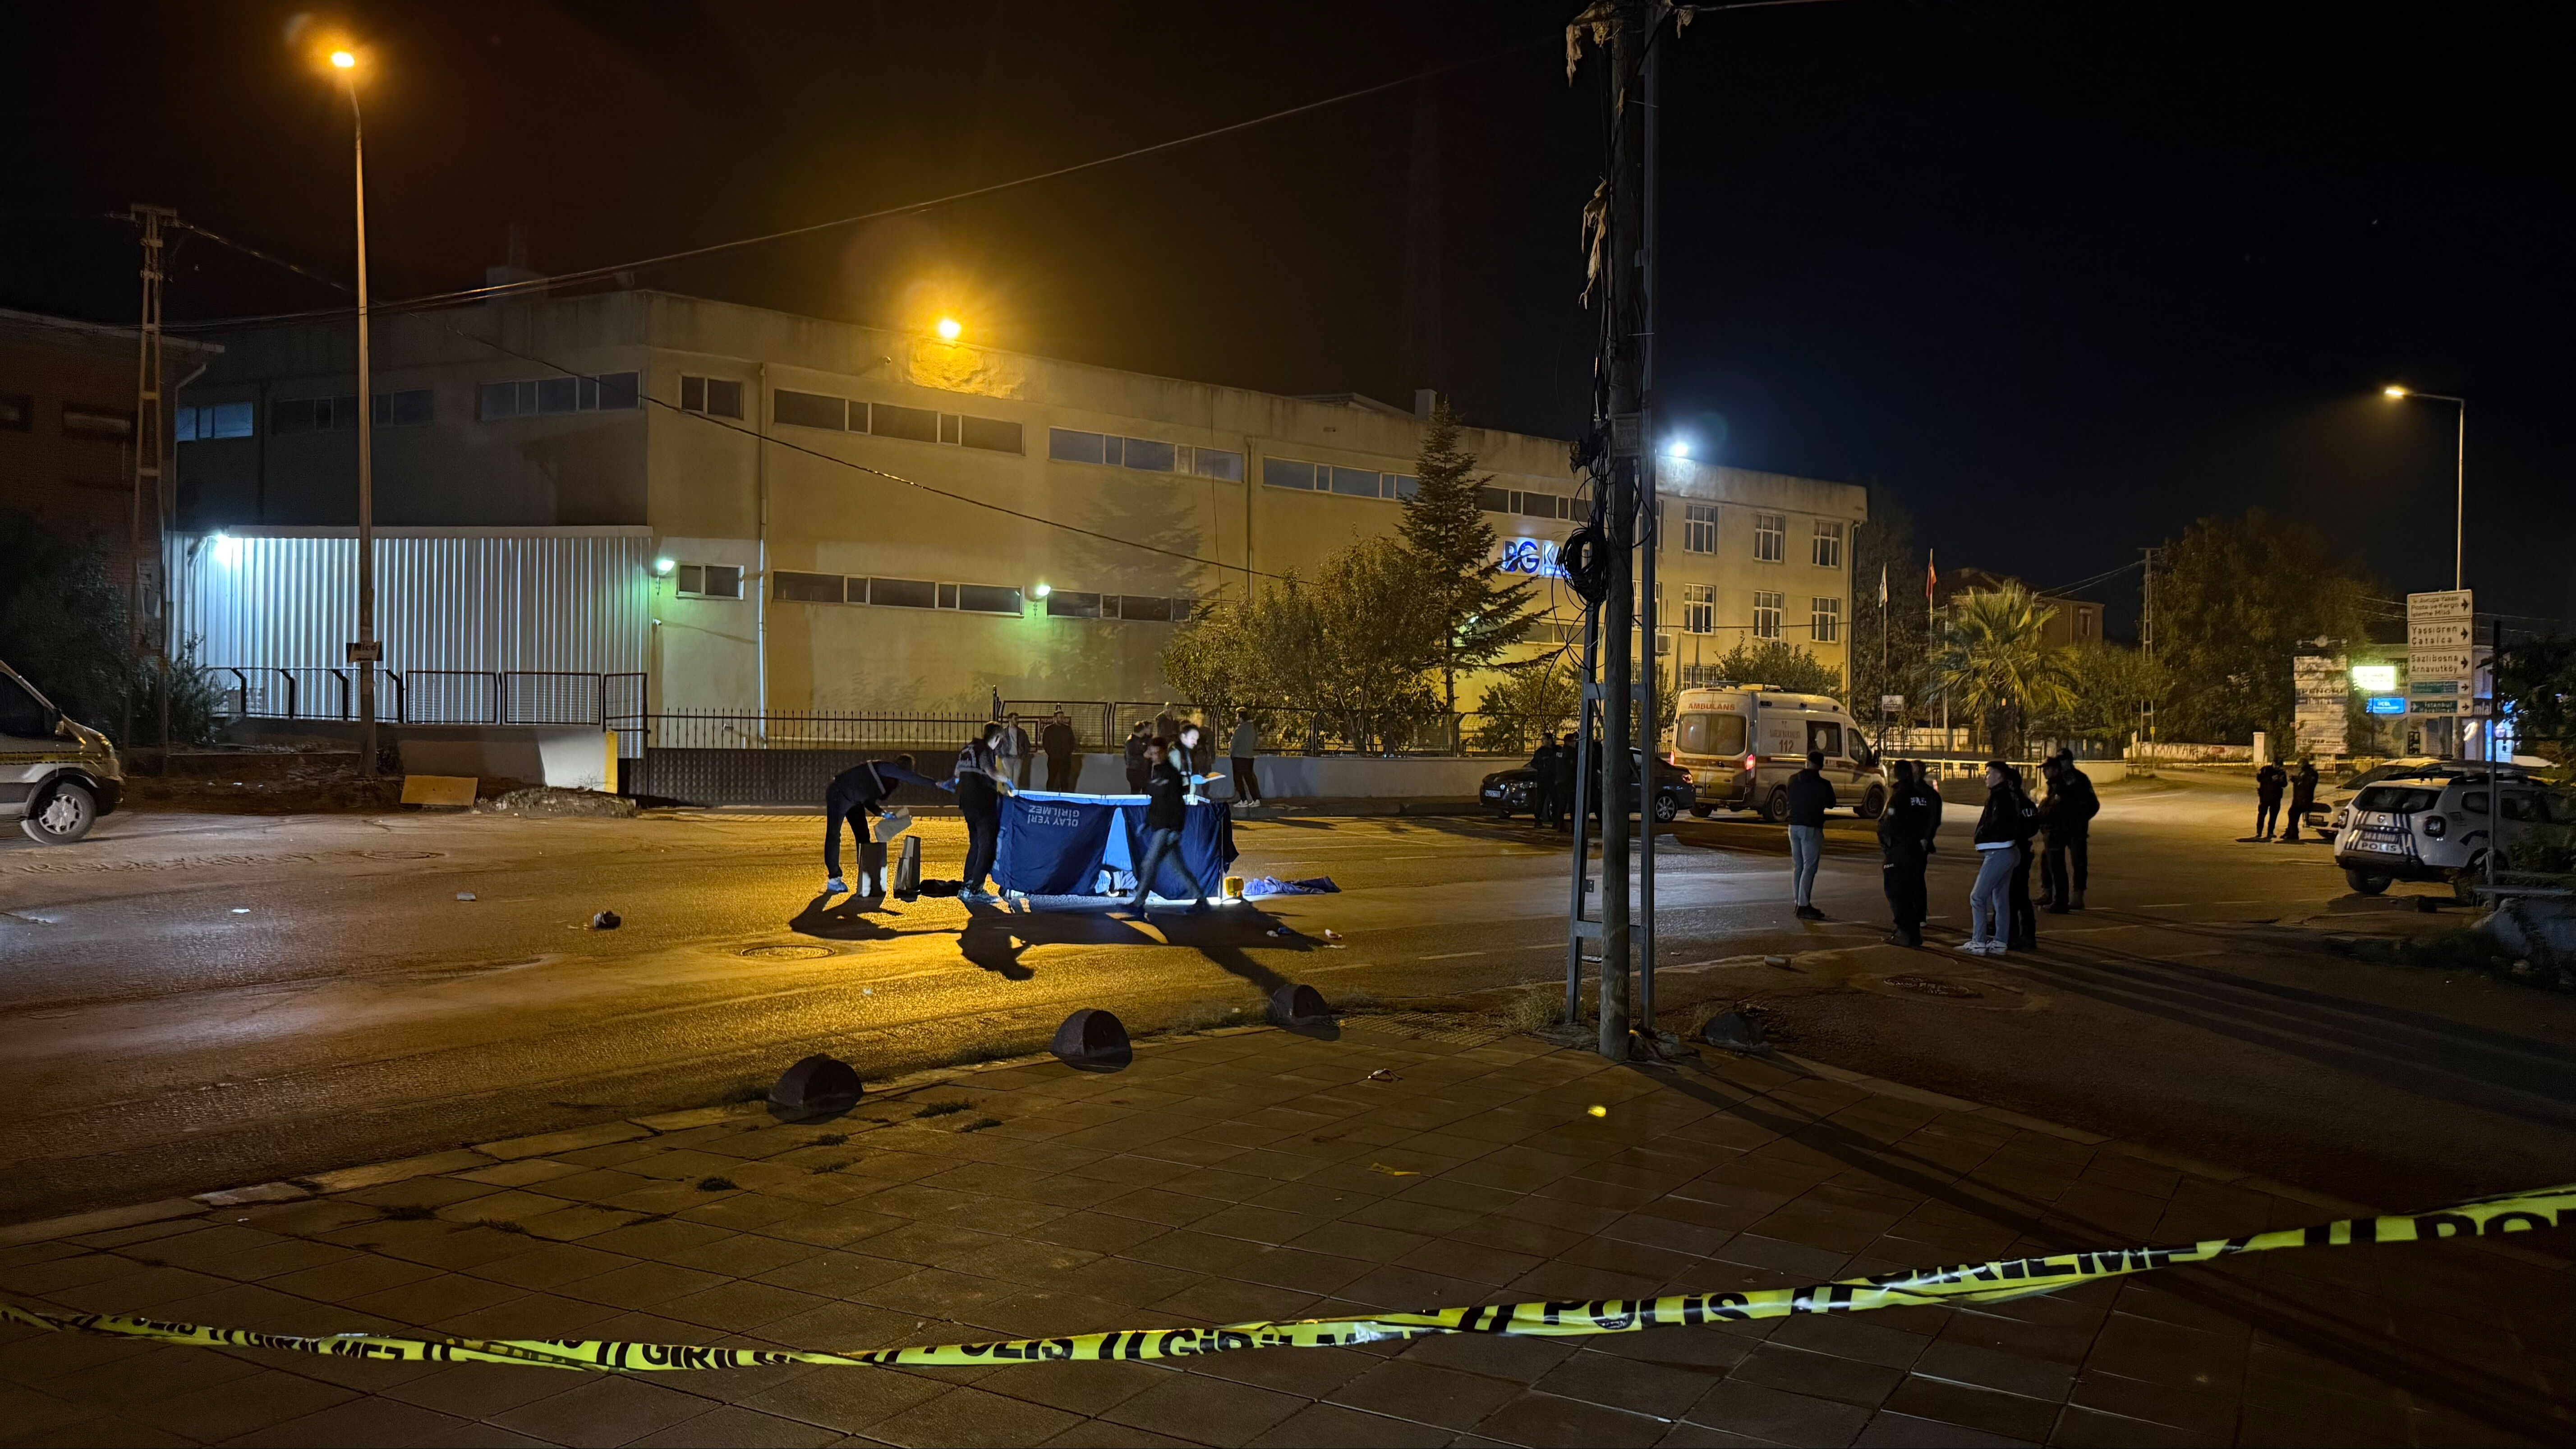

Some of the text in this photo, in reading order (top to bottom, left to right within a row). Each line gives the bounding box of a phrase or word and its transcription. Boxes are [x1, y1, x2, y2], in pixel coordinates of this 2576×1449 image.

[2412, 636, 2452, 646] Çatalca
[1688, 703, 1735, 711] AMBULANS
[1779, 739, 1794, 753] 112
[1027, 814, 1078, 827] OLAY YERİ
